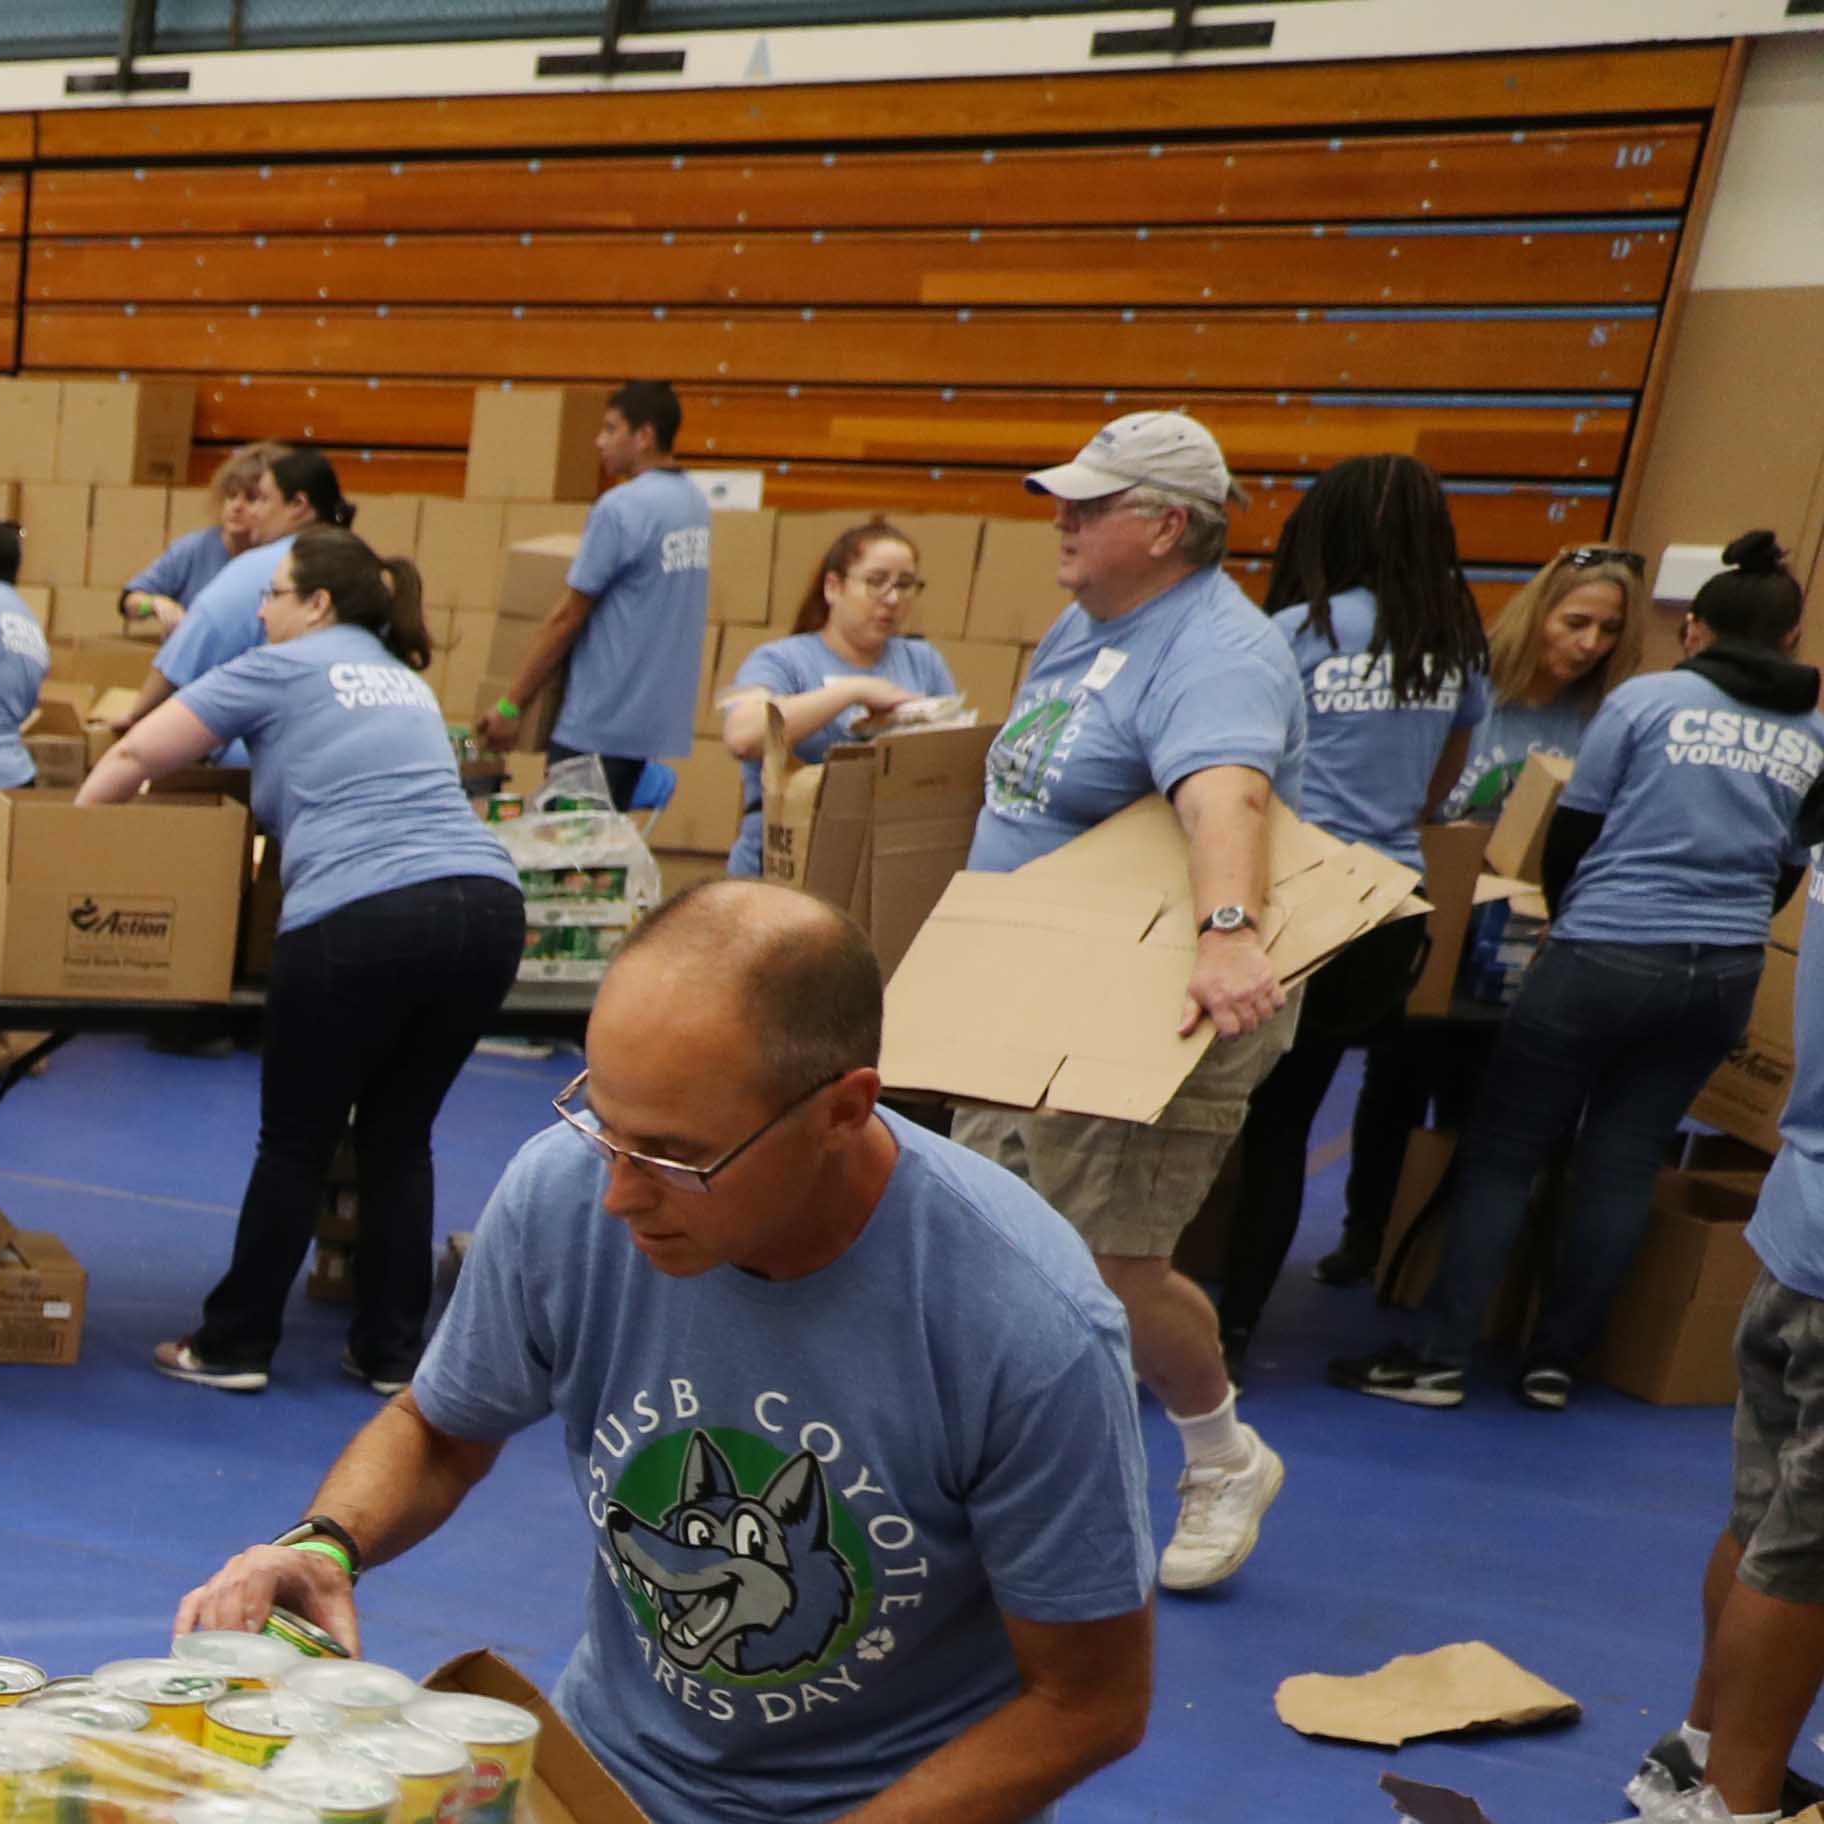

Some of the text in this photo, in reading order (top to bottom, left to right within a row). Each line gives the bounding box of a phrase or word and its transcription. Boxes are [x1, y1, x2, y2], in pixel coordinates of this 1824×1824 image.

[95, 910, 168, 937] Action
[587, 1377, 927, 1616] CSUSB COYOTE
[756, 1668, 862, 1725] DAY
